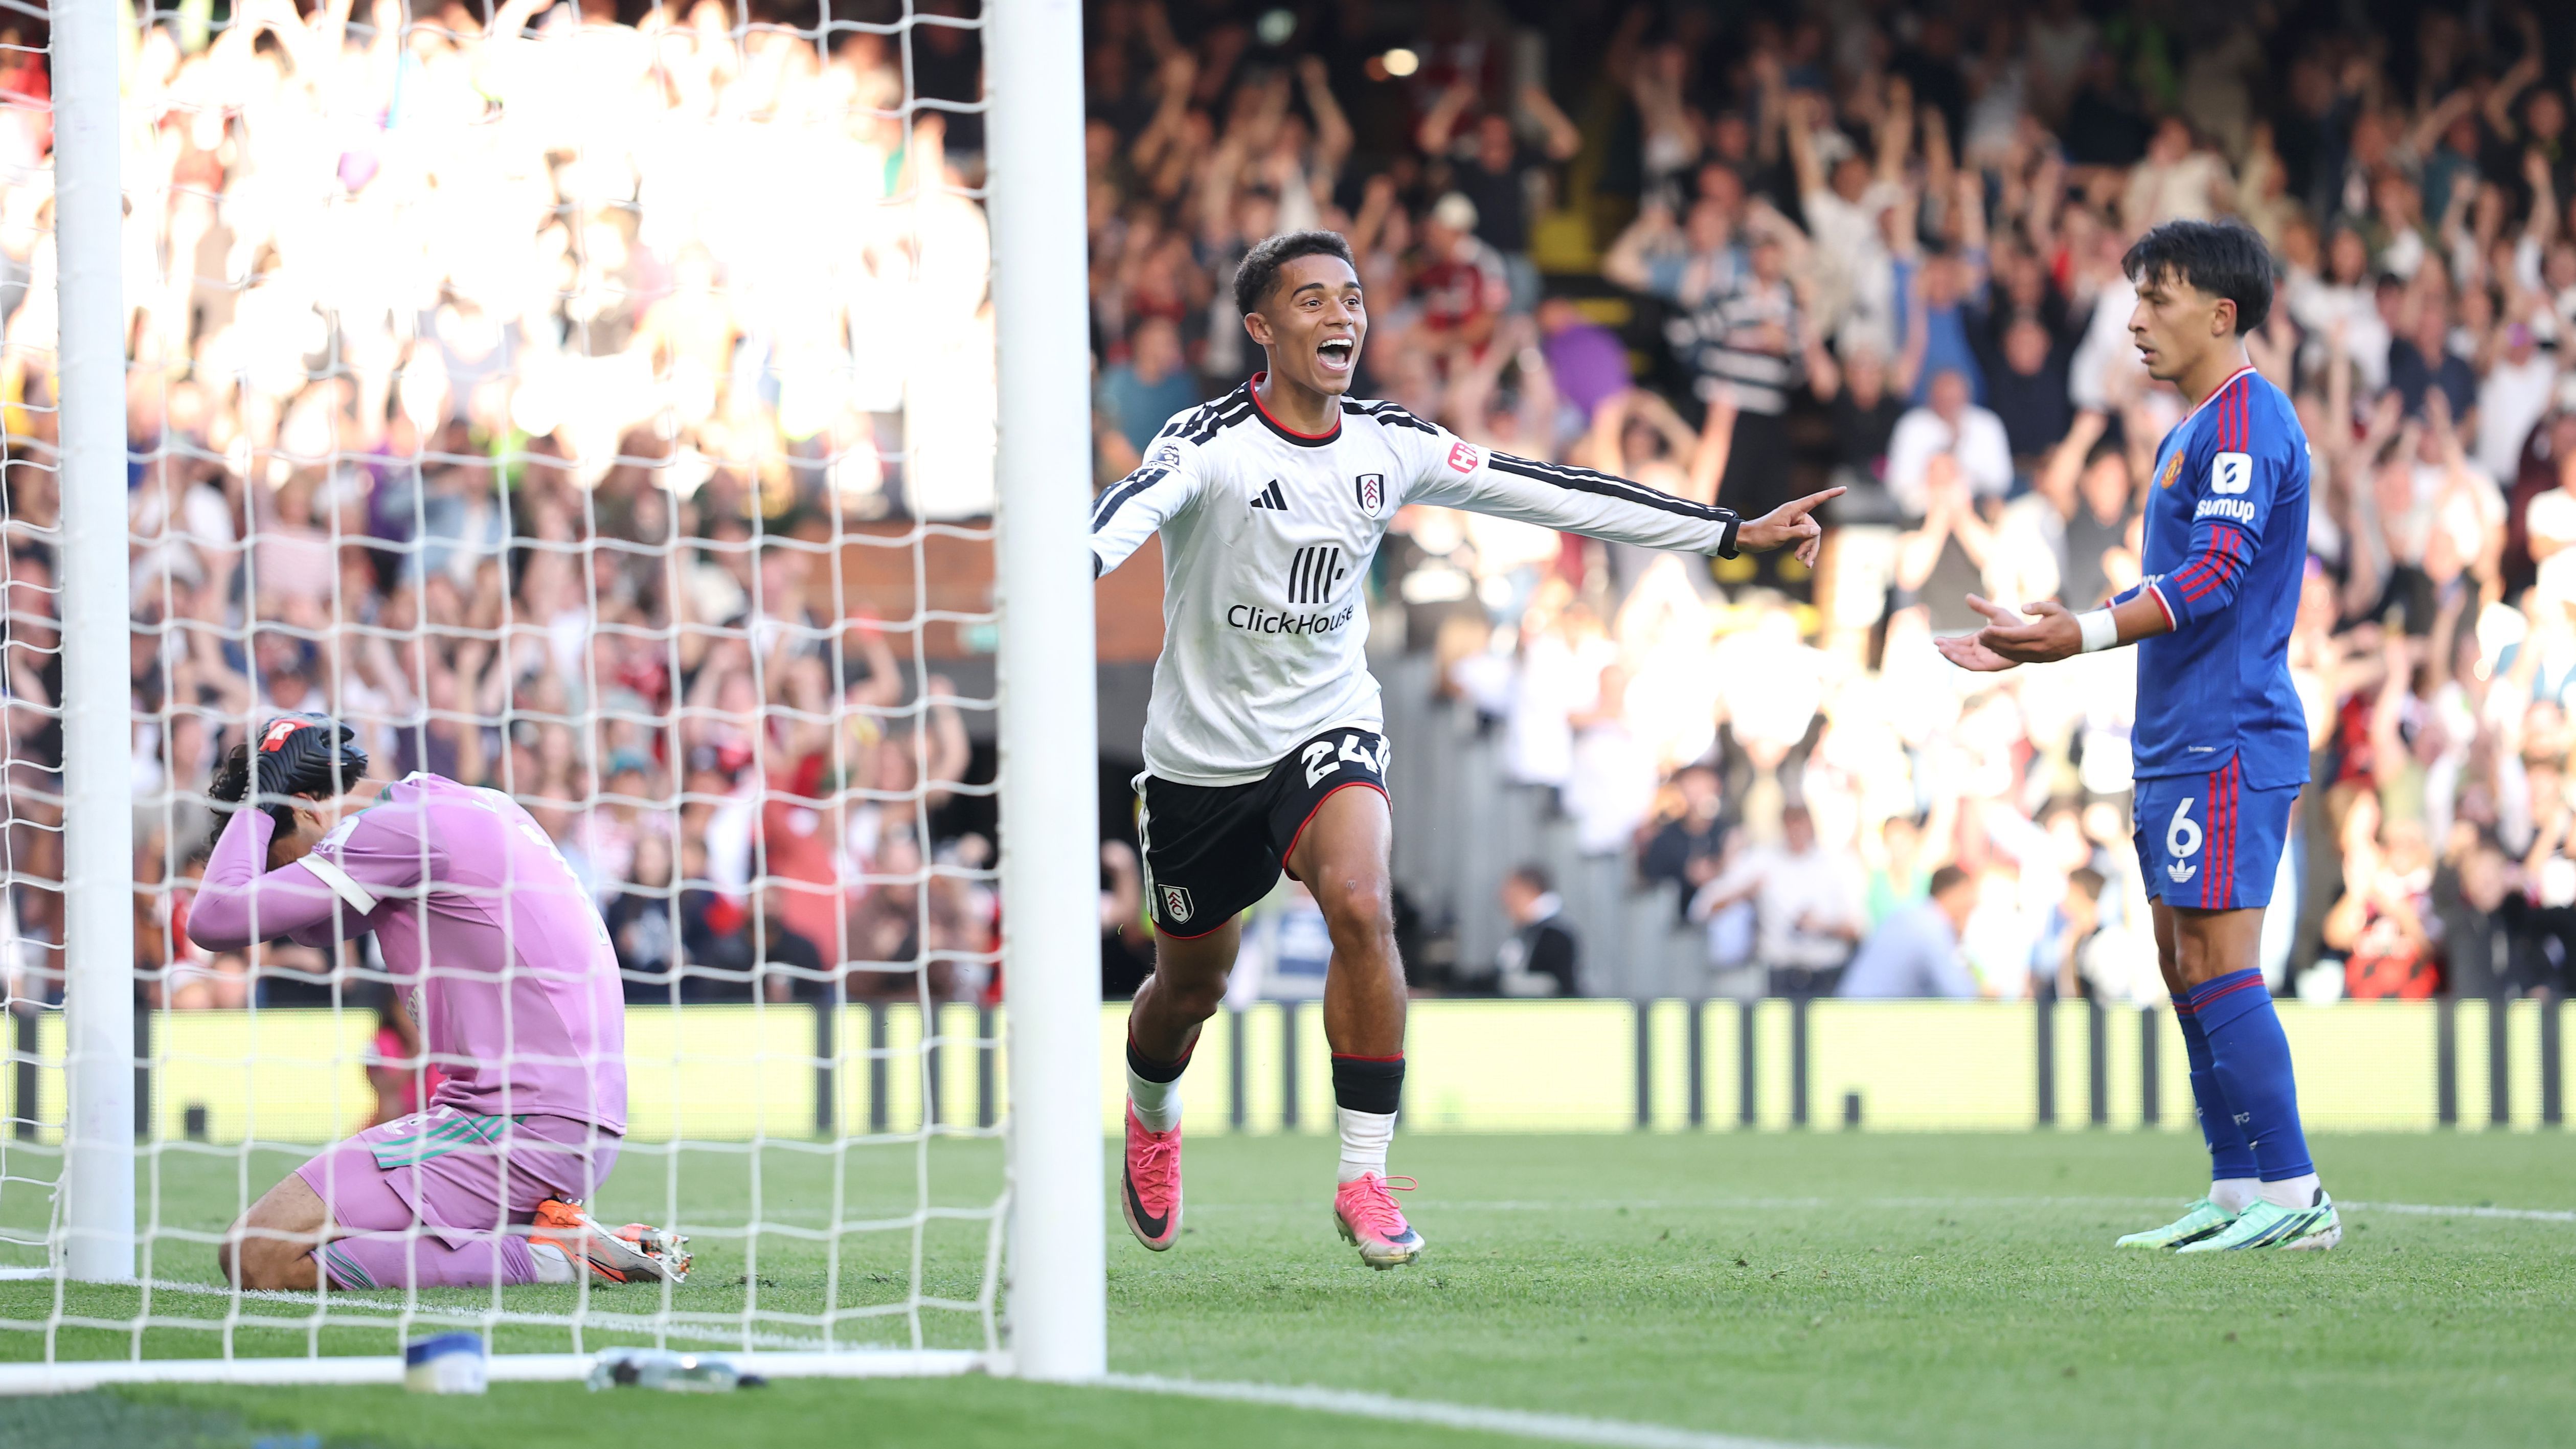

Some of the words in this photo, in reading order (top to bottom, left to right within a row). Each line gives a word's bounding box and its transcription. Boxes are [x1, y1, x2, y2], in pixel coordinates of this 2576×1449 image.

[1364, 479, 1377, 509] FFC
[2196, 499, 2255, 524] sumup
[1228, 604, 1354, 635] ClickHouse
[1301, 734, 1380, 789] 24
[2166, 797, 2203, 858] 6
[1168, 892, 1184, 916] FFC
